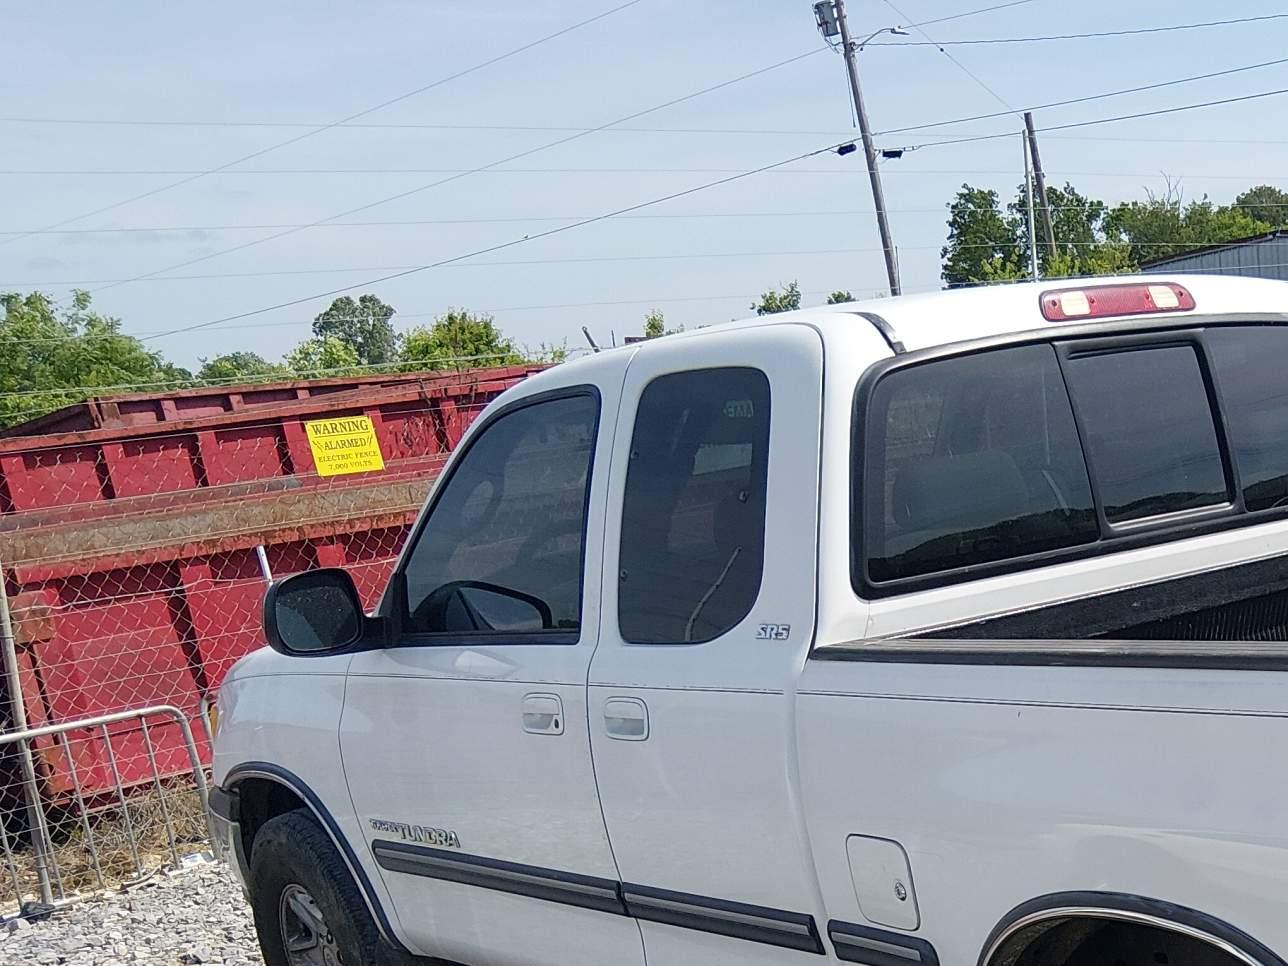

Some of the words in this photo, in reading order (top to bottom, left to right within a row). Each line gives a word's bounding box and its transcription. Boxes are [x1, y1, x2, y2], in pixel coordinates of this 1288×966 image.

[311, 419, 369, 436] WARNING
[324, 437, 367, 451] ALARMED
[318, 453, 354, 463] ELECTRIC
[355, 450, 379, 460] FENCE
[350, 459, 373, 469] VOLTS
[755, 623, 791, 641] SR5
[399, 823, 461, 848] TUNDRA
